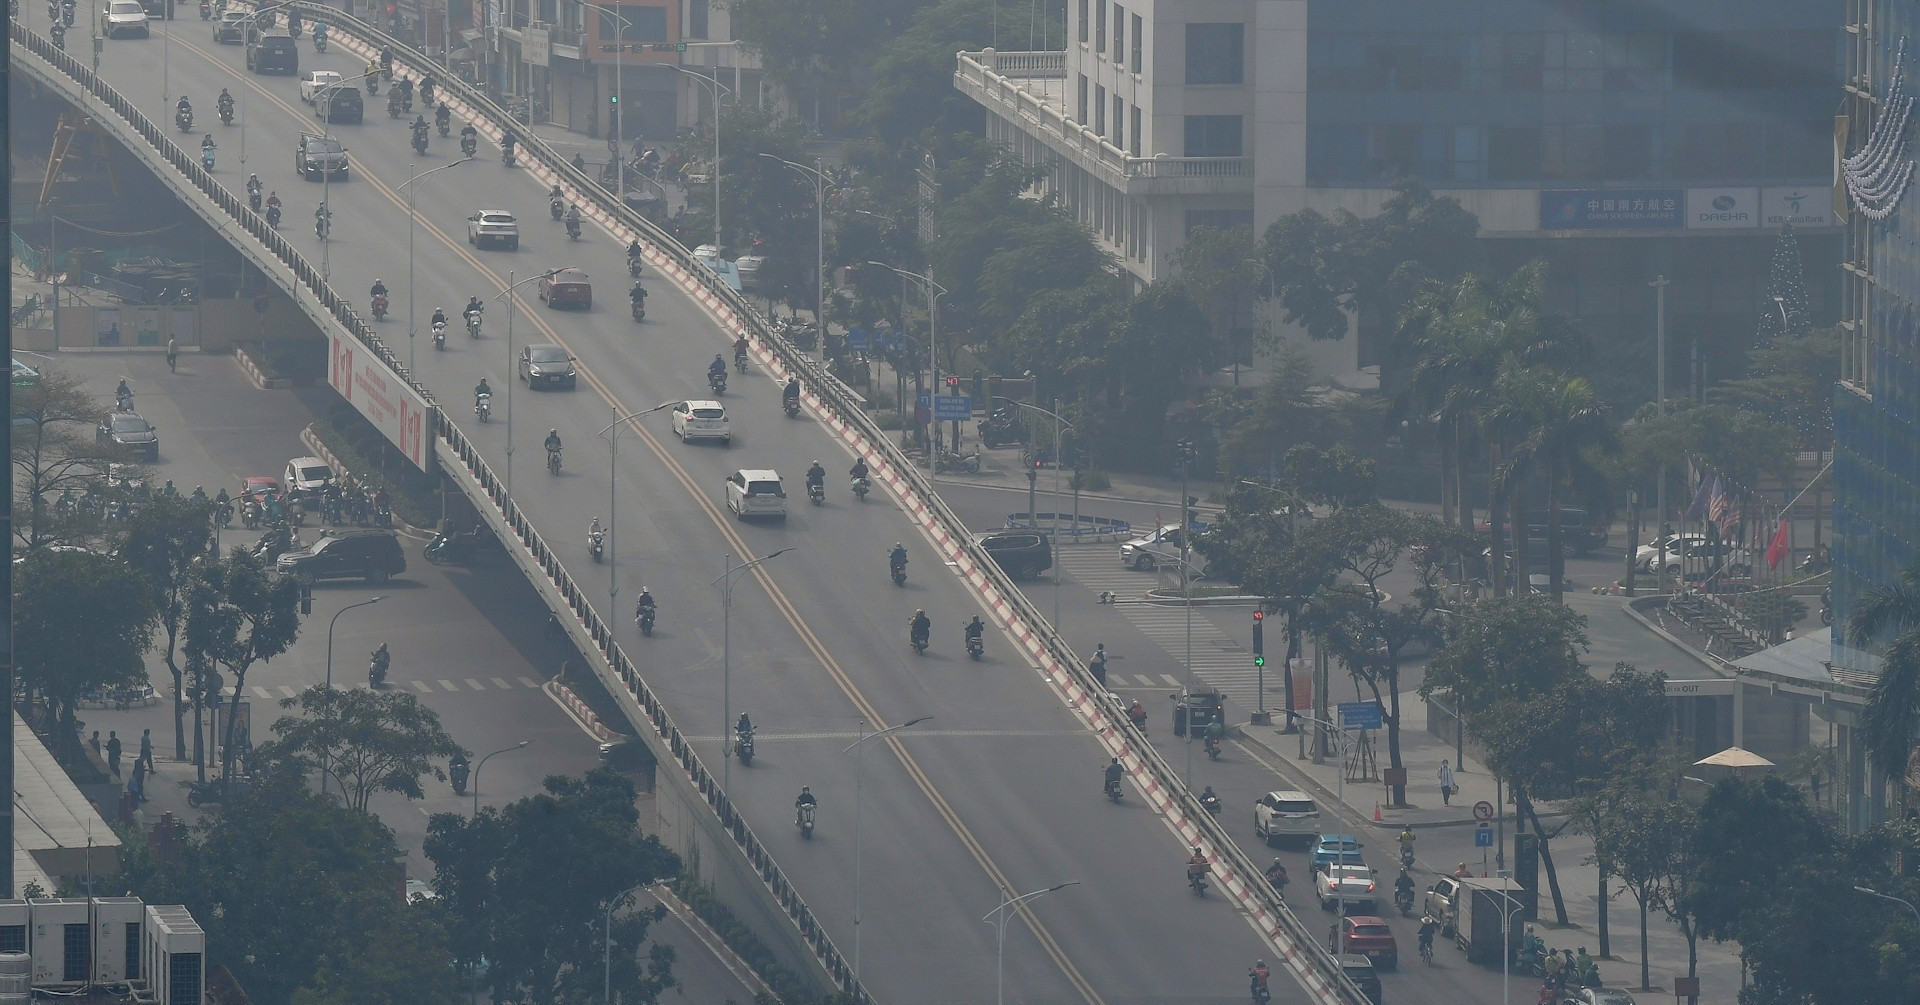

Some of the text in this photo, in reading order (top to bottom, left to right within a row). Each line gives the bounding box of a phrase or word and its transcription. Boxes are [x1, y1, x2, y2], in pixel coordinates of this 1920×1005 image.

[1587, 198, 1675, 211] 中国南方航空
[1699, 213, 1748, 222] DAEHA
[1768, 215, 1783, 223] KEB
[1805, 215, 1824, 223] Bank
